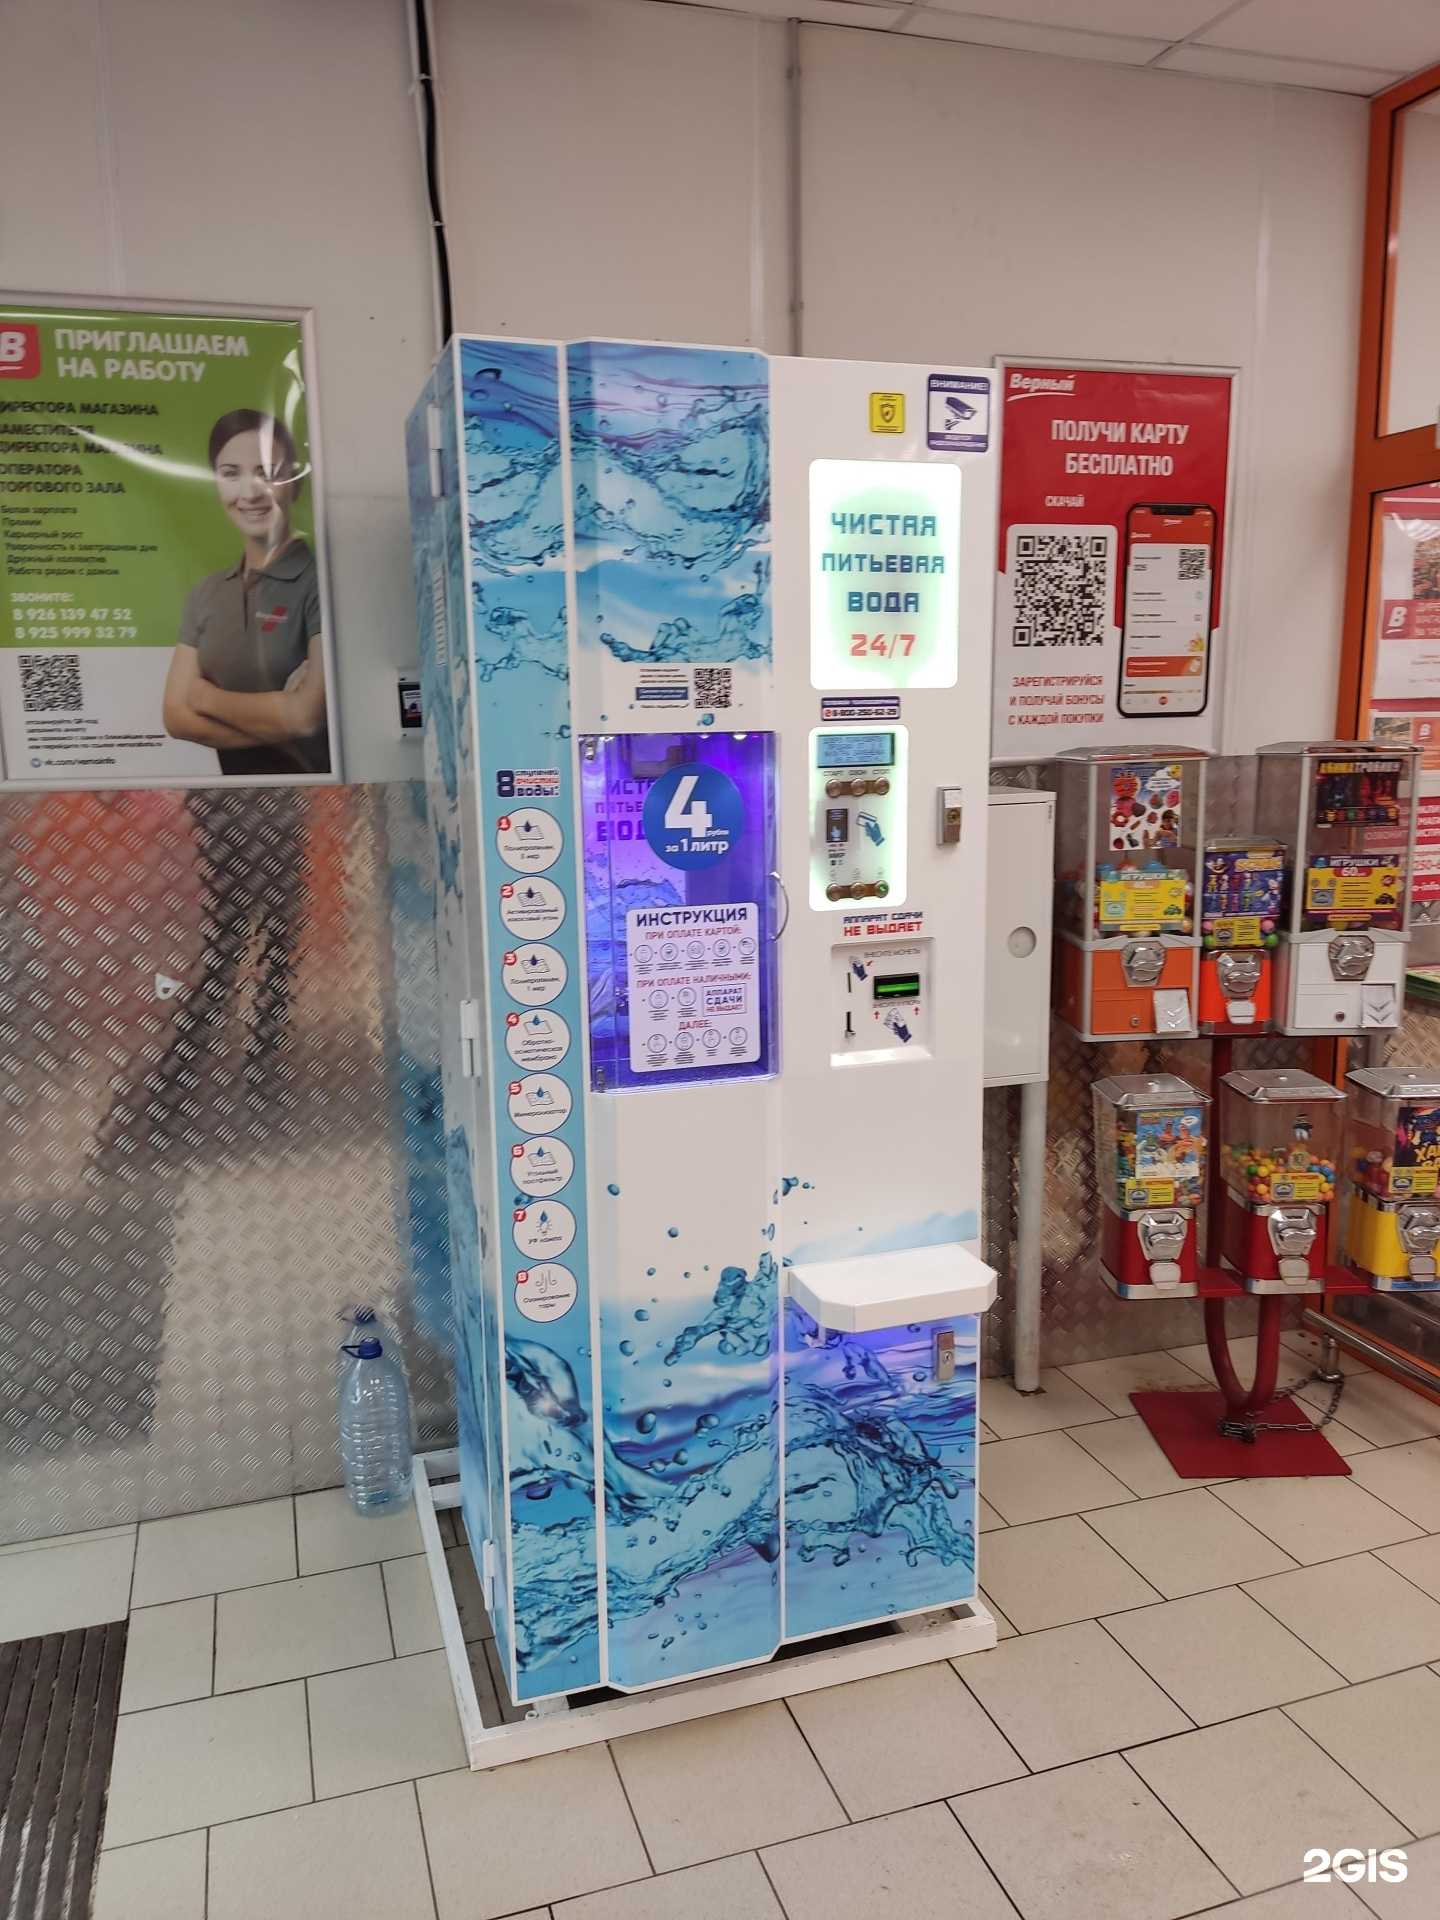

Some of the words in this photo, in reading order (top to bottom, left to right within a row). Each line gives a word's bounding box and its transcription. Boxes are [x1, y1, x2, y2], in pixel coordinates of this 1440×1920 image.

[54, 328, 249, 357] ПРИГЛАШАЕМ
[57, 357, 97, 379] НА
[104, 358, 206, 382] РАБОТУ
[1009, 373, 1076, 392] Верный
[0, 401, 76, 413] ИРЕКТОРА
[80, 402, 159, 416] МАГАЗИНА
[1052, 420, 1127, 442] ПОЛУЧИ
[1130, 424, 1189, 445] КАРТУ
[1065, 453, 1174, 476] БЕСПЛАТНО
[86, 482, 126, 494] ЗАЛА
[1045, 494, 1085, 507] СКАЧАЙ
[831, 512, 937, 537] ЧИСТАЯ
[821, 552, 945, 574] ПИТЬЕВАЯ
[848, 591, 920, 613] ВОДА
[90, 608, 109, 621] 47
[112, 608, 132, 621] 52
[850, 633, 917, 658] 24/7
[497, 770, 514, 797] 8
[664, 775, 713, 838] 4
[665, 843, 679, 853] за
[681, 838, 689, 852] 1
[691, 840, 730, 855] литр
[637, 908, 747, 927] ИНСТРУКЦИЯ
[844, 914, 888, 924] АППАРАТ
[891, 911, 923, 921] СДАЧИ
[645, 931, 664, 940] ПРИ
[667, 928, 702, 939] ОПЛАТЕ
[844, 926, 861, 936] НЕ
[867, 921, 922, 935] ВЫДАЕТ
[637, 979, 654, 988] ПРИ
[657, 976, 690, 987] ОПЛАТЕ
[706, 995, 743, 1005] СДАЧИ
